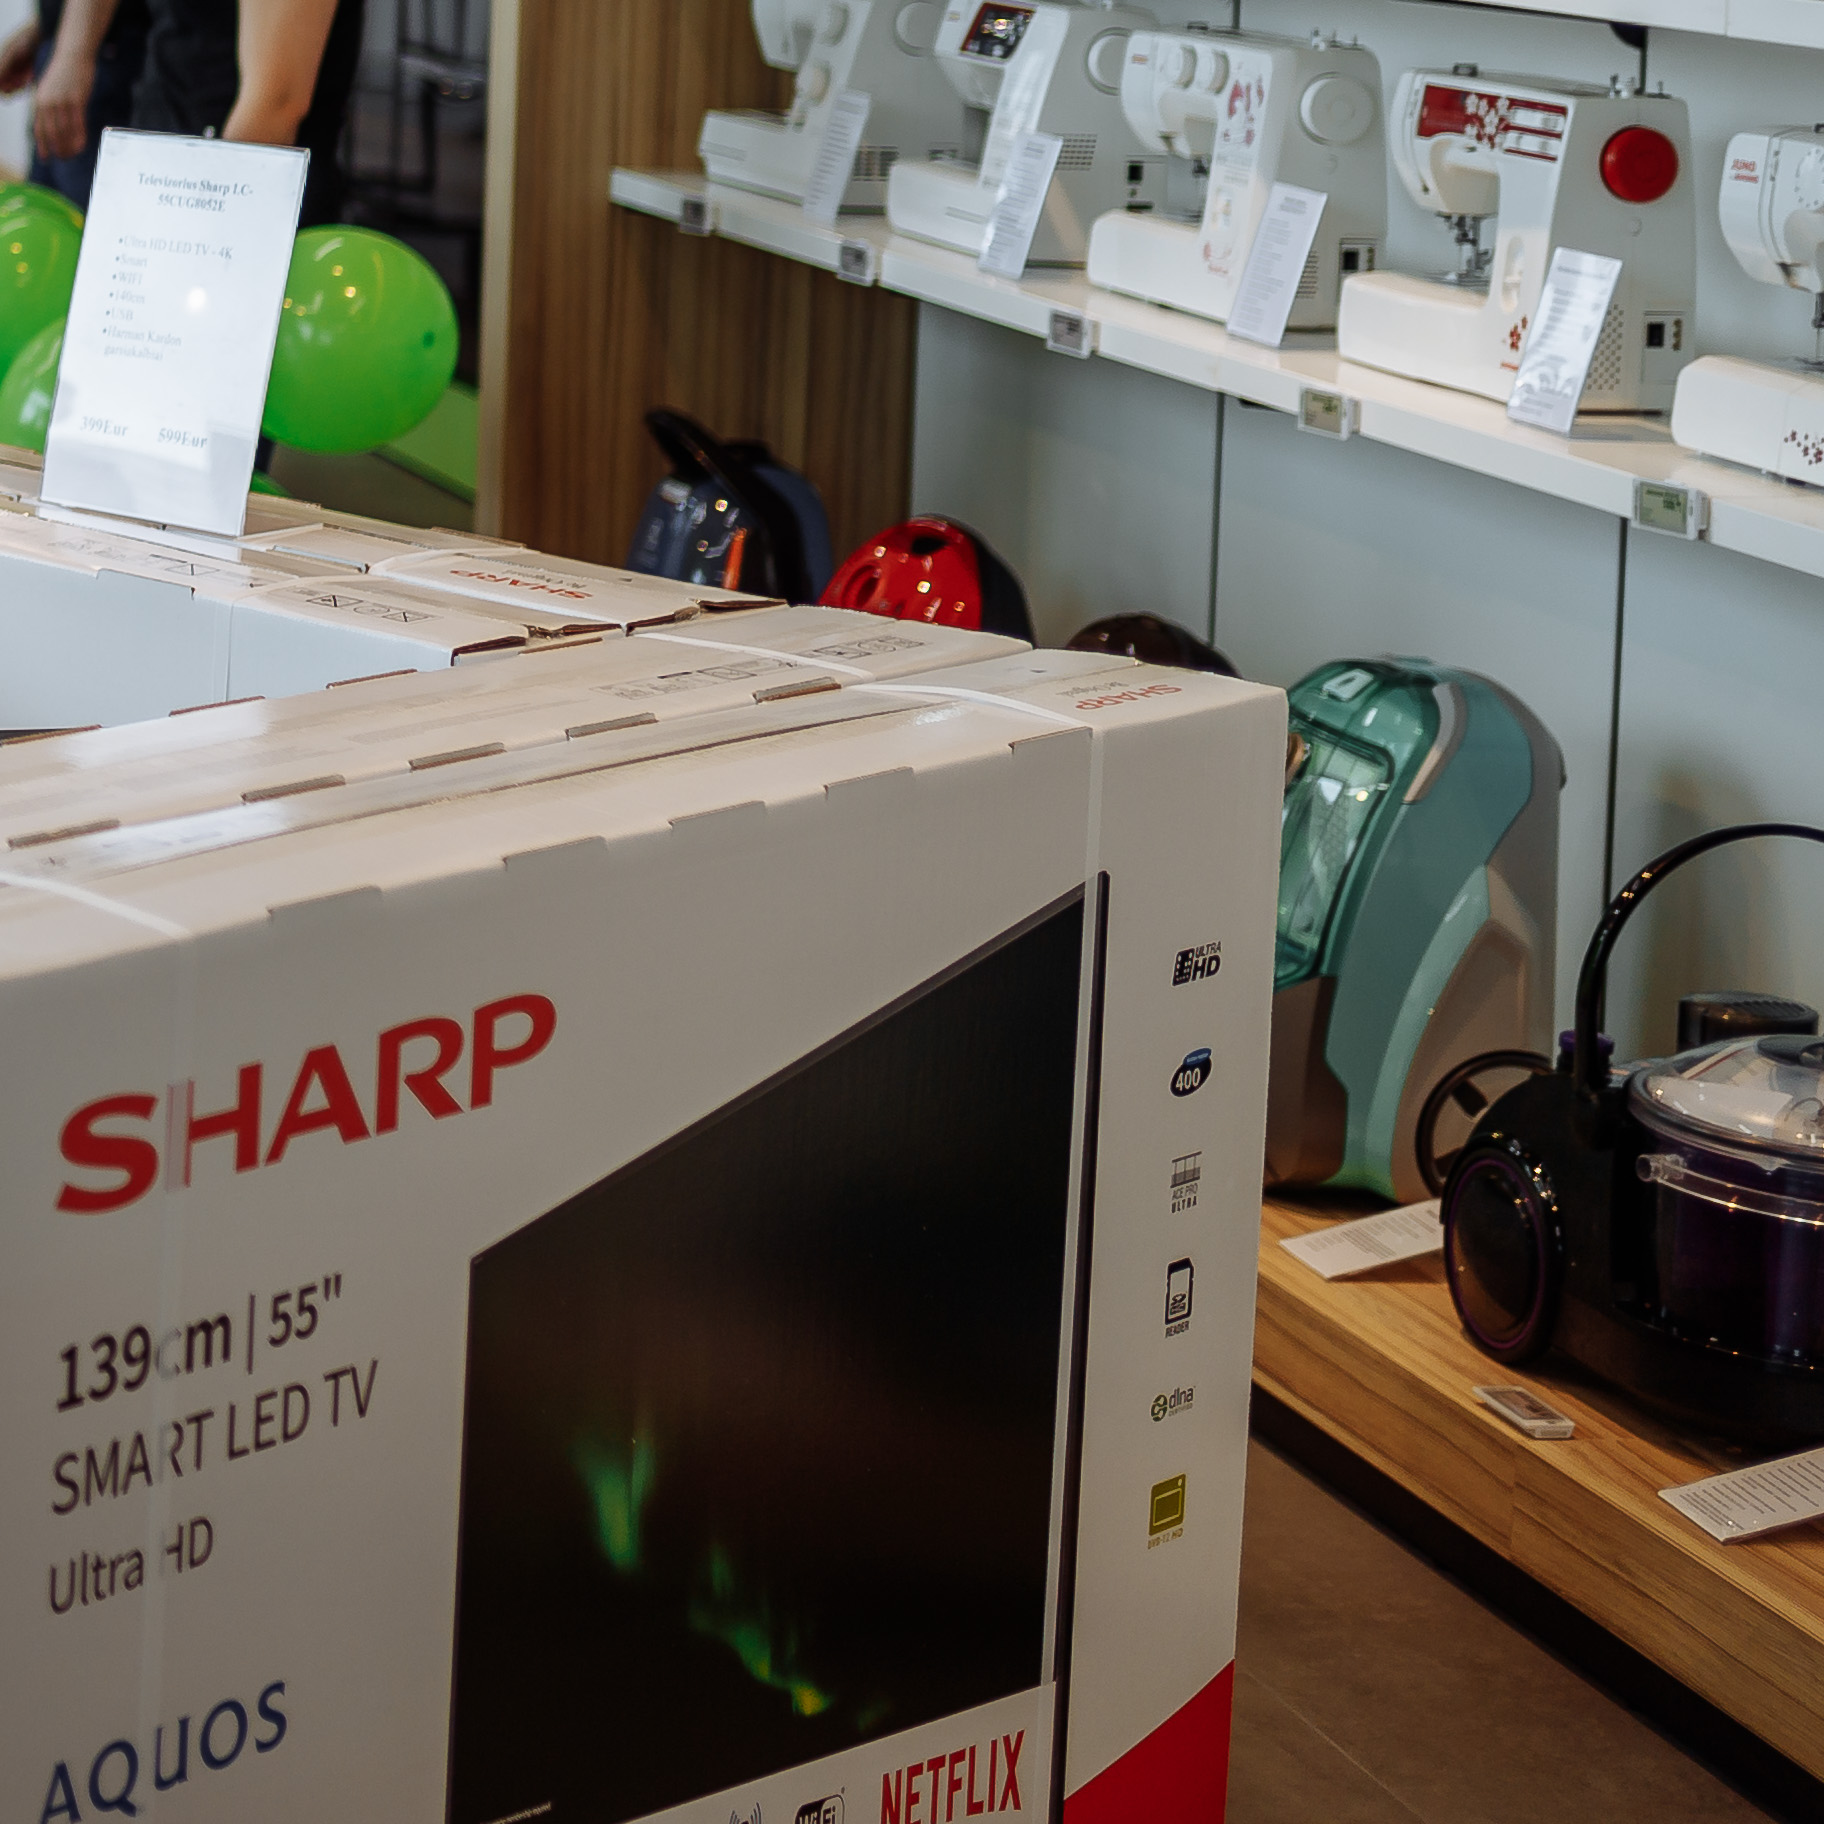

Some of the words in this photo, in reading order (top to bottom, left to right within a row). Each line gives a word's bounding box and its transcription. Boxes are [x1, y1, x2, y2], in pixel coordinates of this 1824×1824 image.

[138, 172, 198, 191] Televizorius
[199, 179, 230, 196] Sharp
[120, 252, 148, 268] Smart
[150, 238, 166, 251] HD
[169, 241, 191, 254] LED
[194, 244, 210, 256] TV
[219, 247, 232, 260] 4K
[107, 324, 145, 343] Harman
[148, 329, 182, 346] Kardon
[157, 428, 208, 449] 599Eur
[1194, 941, 1222, 959] ULTRA
[1191, 955, 1221, 981] HD
[1175, 1067, 1201, 1092] 400
[54, 992, 558, 1216] SHARP
[1172, 1186, 1184, 1200] ACE
[1185, 1183, 1198, 1197] PRO
[1171, 1195, 1198, 1214] ULTRA
[1165, 1320, 1190, 1338] READER
[1169, 1386, 1194, 1408] dlna
[226, 1384, 311, 1462] LED
[323, 1359, 379, 1427] TV
[49, 1548, 145, 1615] Ultra
[39, 1679, 289, 1824] AQUOS
[880, 1729, 1025, 1824] NETFLIX
